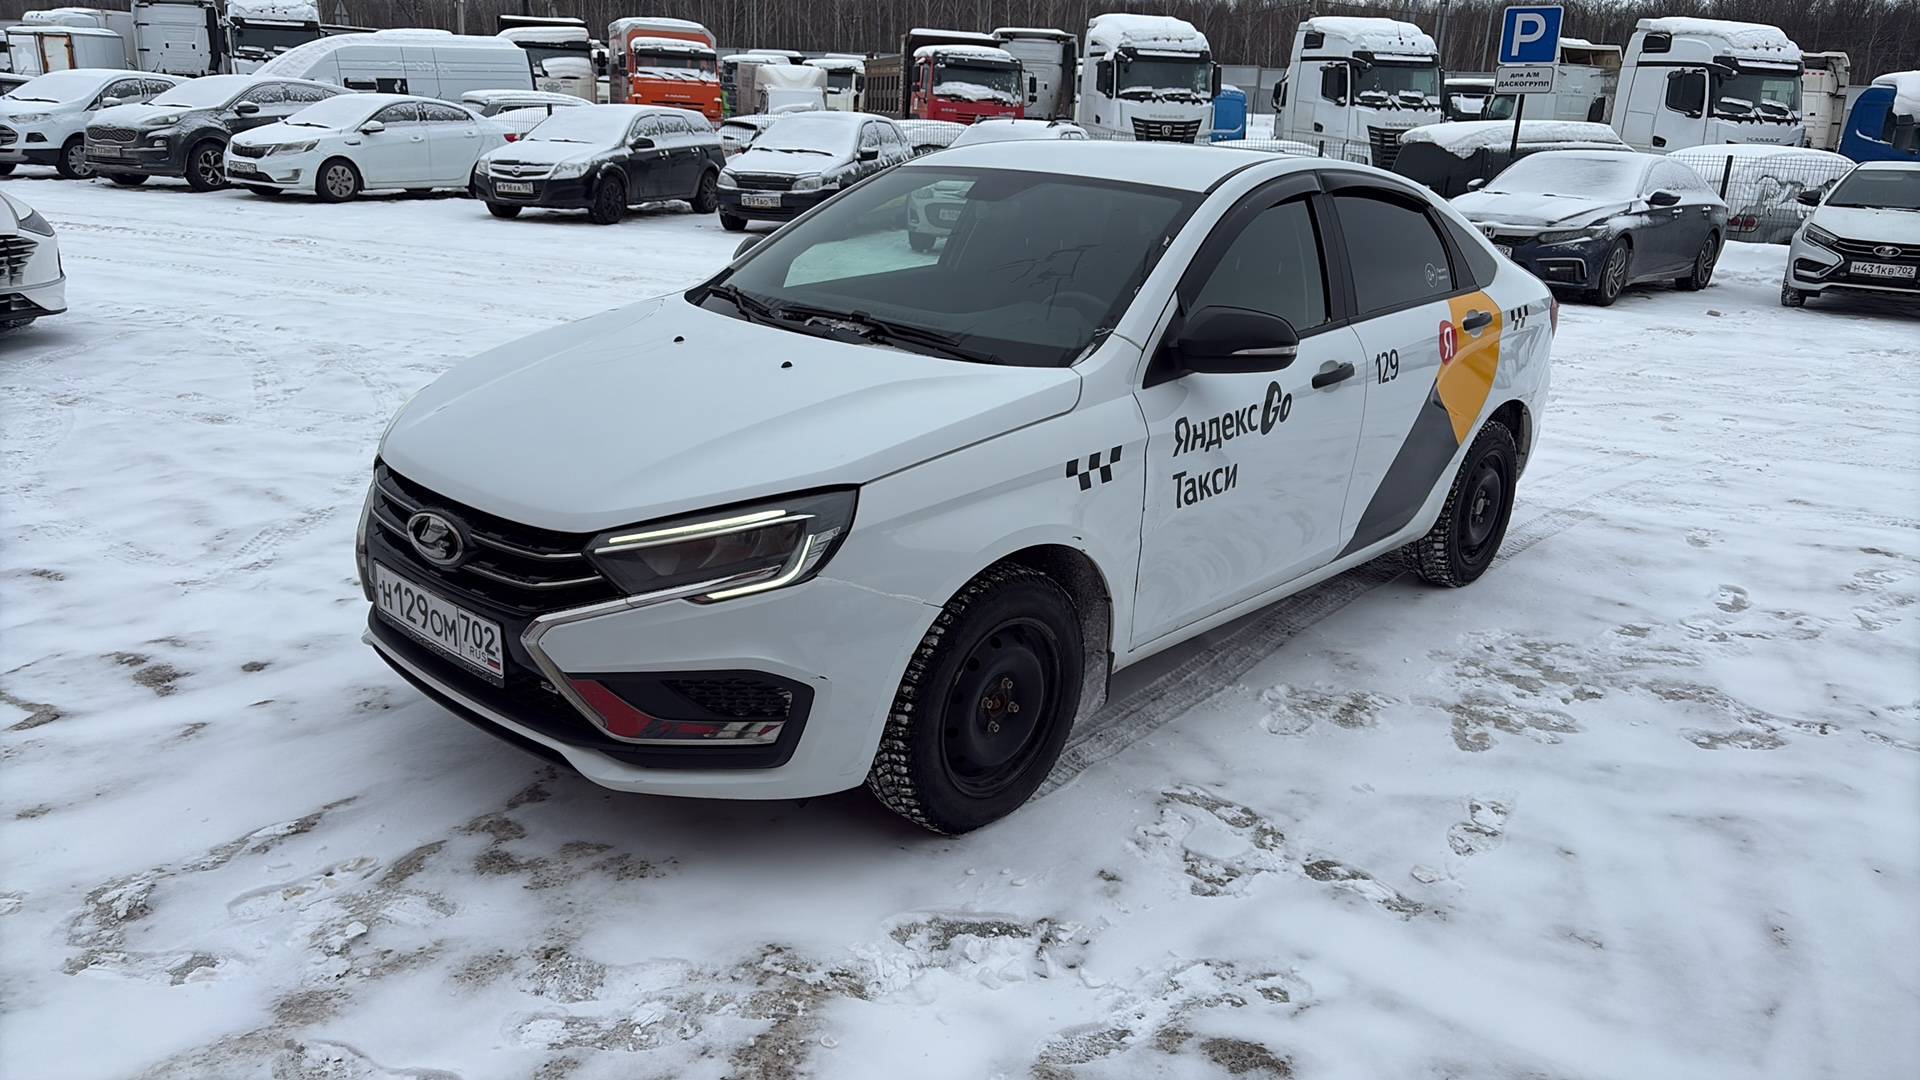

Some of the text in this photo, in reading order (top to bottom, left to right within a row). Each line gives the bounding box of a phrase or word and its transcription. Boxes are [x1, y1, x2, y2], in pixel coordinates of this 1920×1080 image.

[1511, 13, 1546, 56] P
[1498, 80, 1550, 88] ДАСКОГРУПП
[1896, 266, 1914, 276] 702
[1444, 326, 1454, 360] Я
[1375, 348, 1399, 385] 129
[1172, 380, 1293, 458] Яндекс Go
[1172, 463, 1239, 509] Такси
[382, 580, 458, 648] Н129ОМ
[460, 613, 497, 657] 702
[469, 645, 488, 663] RUS
